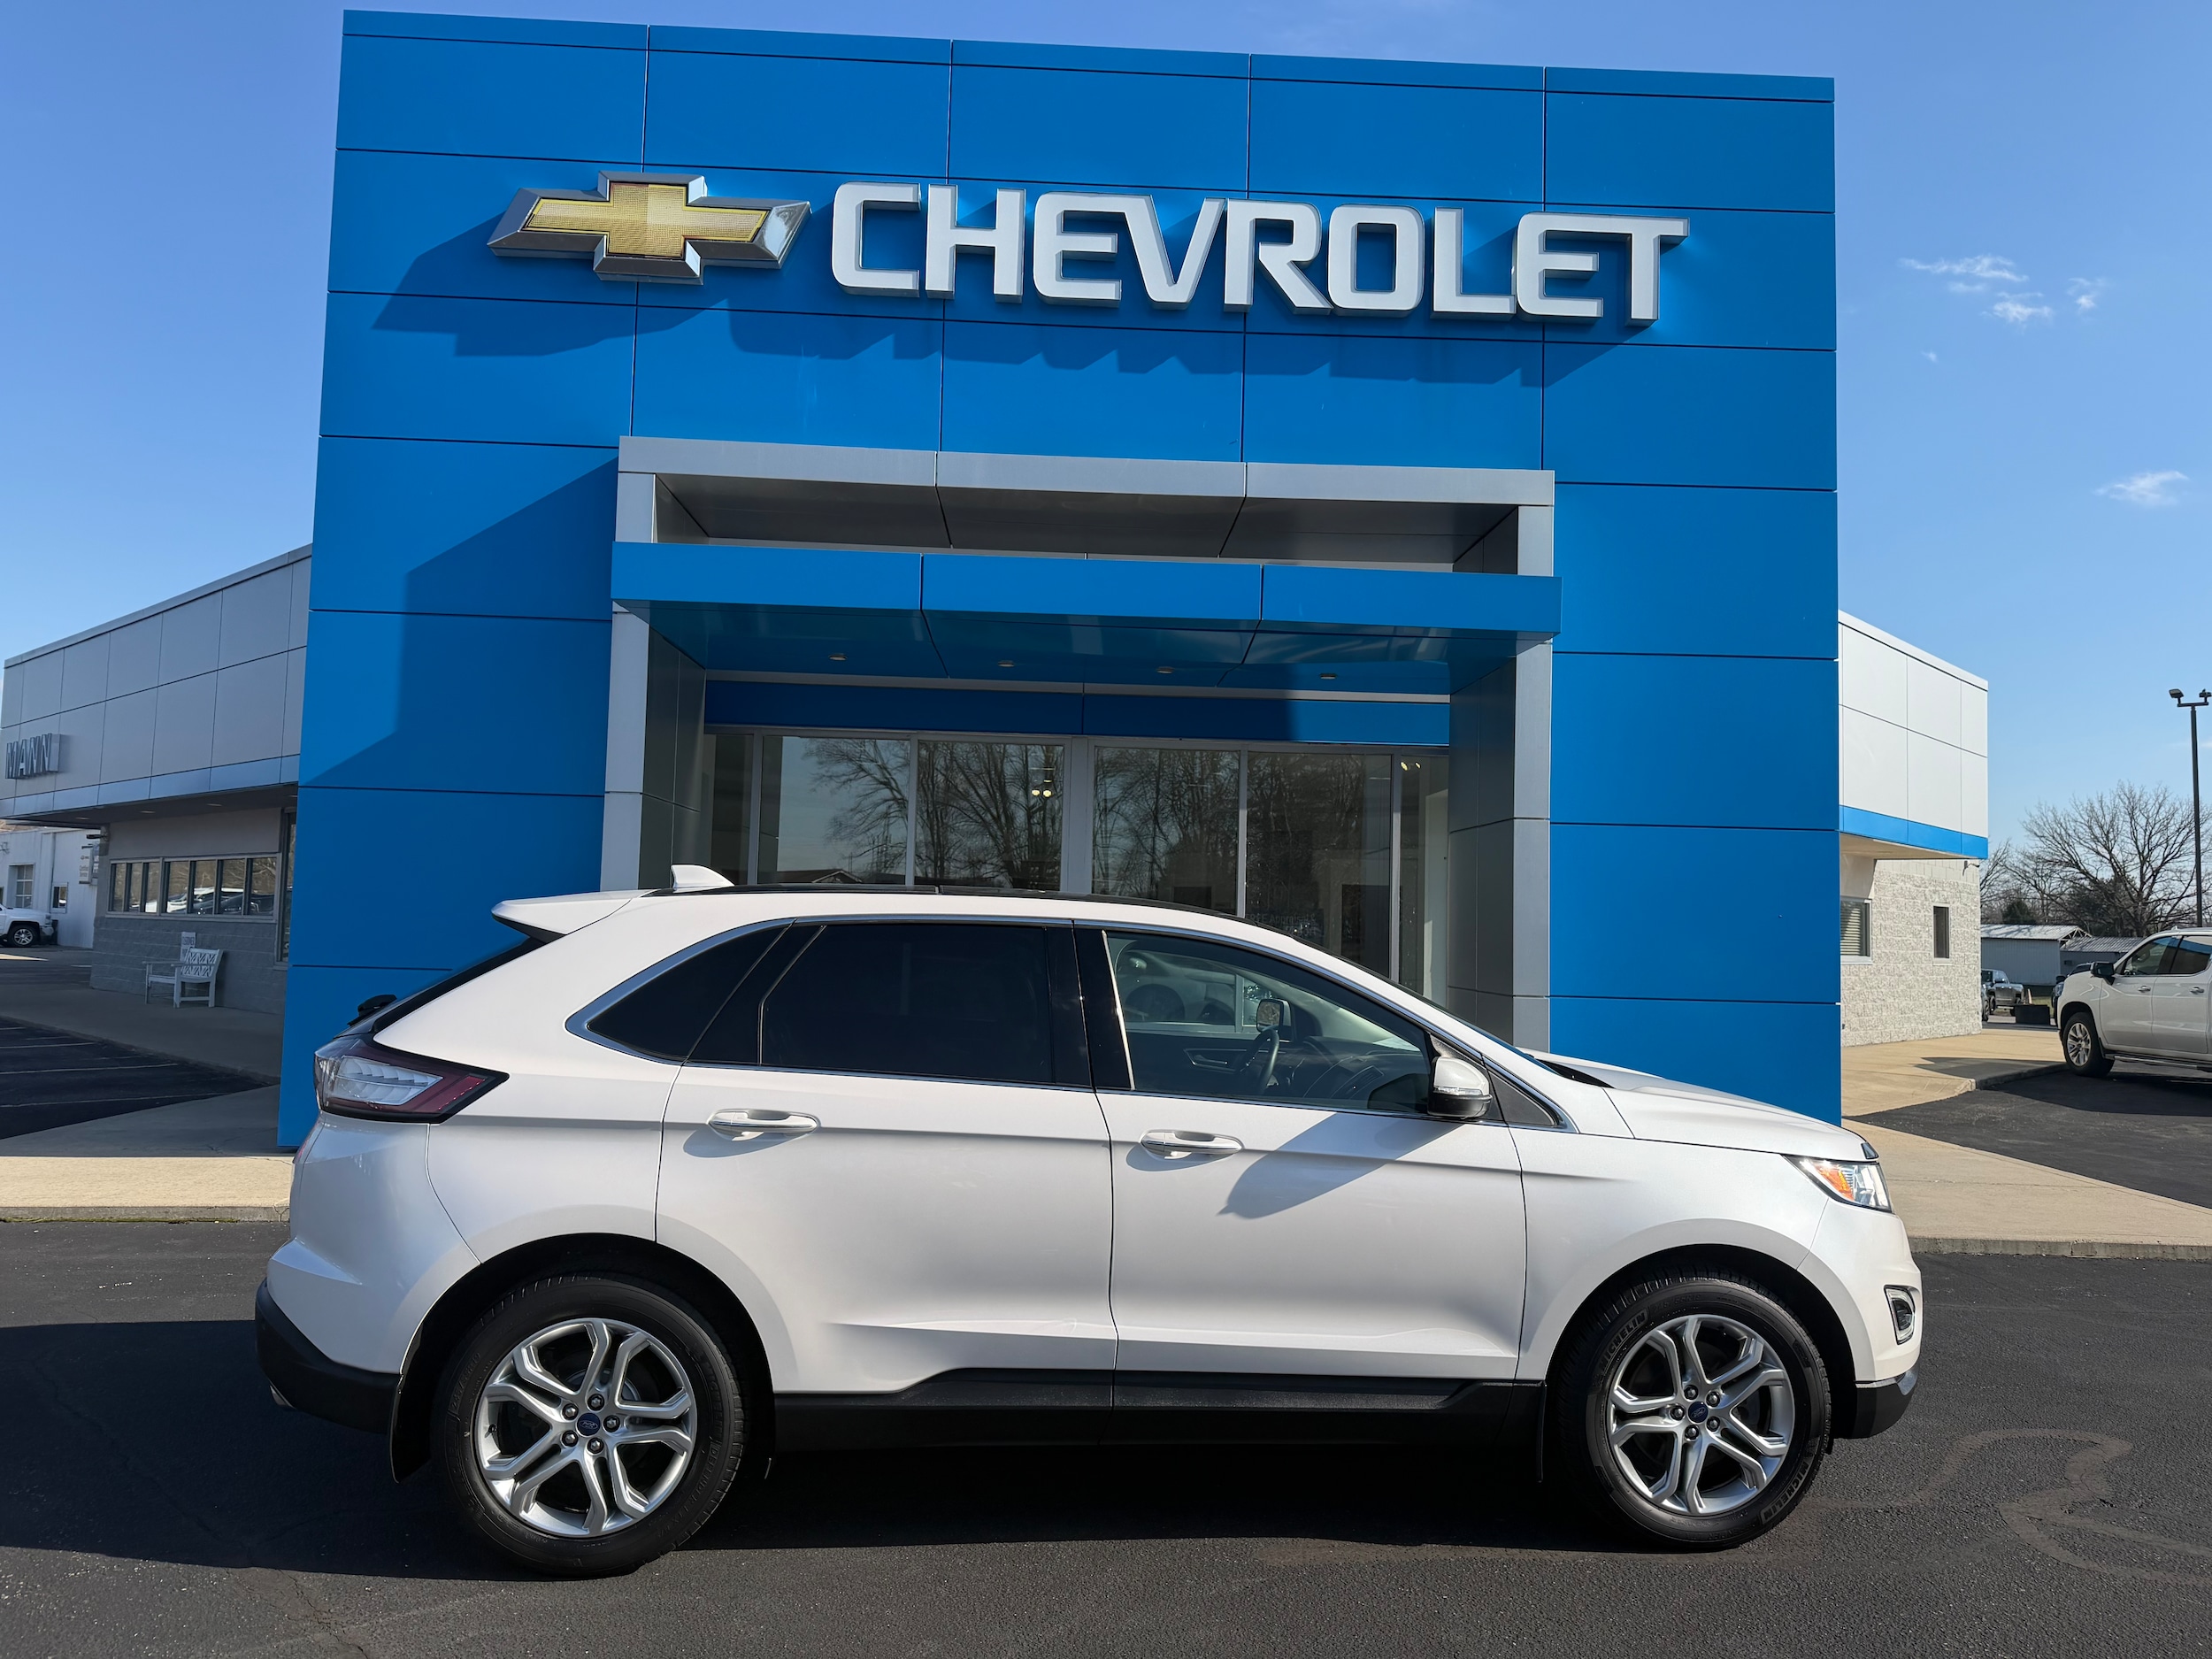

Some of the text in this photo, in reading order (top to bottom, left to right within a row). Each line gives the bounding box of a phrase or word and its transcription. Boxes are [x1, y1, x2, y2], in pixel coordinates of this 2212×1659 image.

[831, 182, 1689, 326] CHEVROLET
[5, 733, 60, 780] MANN
[1597, 1311, 1646, 1371] MICHELIN
[1763, 1460, 1809, 1520] MICHELIN
